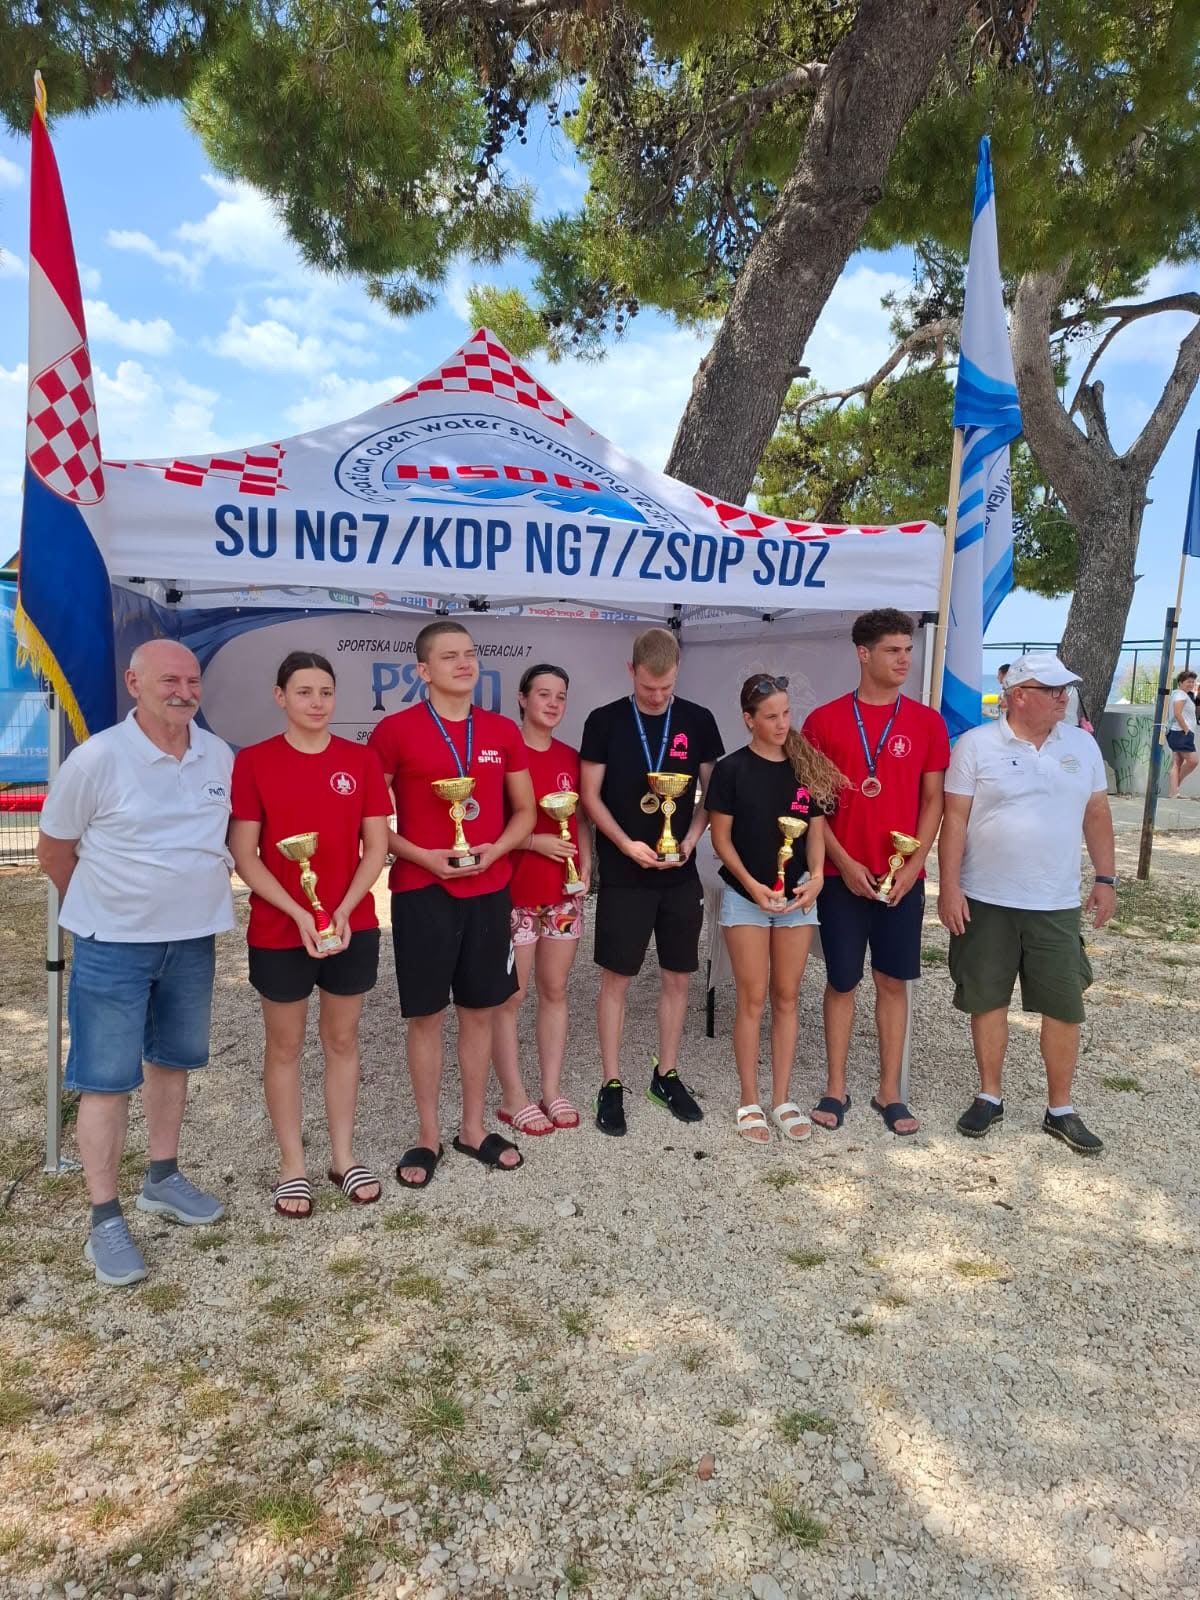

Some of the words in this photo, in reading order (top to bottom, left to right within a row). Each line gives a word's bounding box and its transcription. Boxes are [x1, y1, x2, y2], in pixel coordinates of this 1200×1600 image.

[366, 430, 419, 456] open
[419, 418, 502, 433] water
[509, 426, 629, 494] swimming
[396, 464, 601, 492] HSDP
[214, 503, 278, 559] SU
[295, 508, 512, 571] NG7/KDP
[525, 520, 745, 584] NG7/ZSDP
[752, 537, 831, 589] SDZ
[337, 639, 391, 652] SPORTSKA
[525, 645, 532, 657] 7
